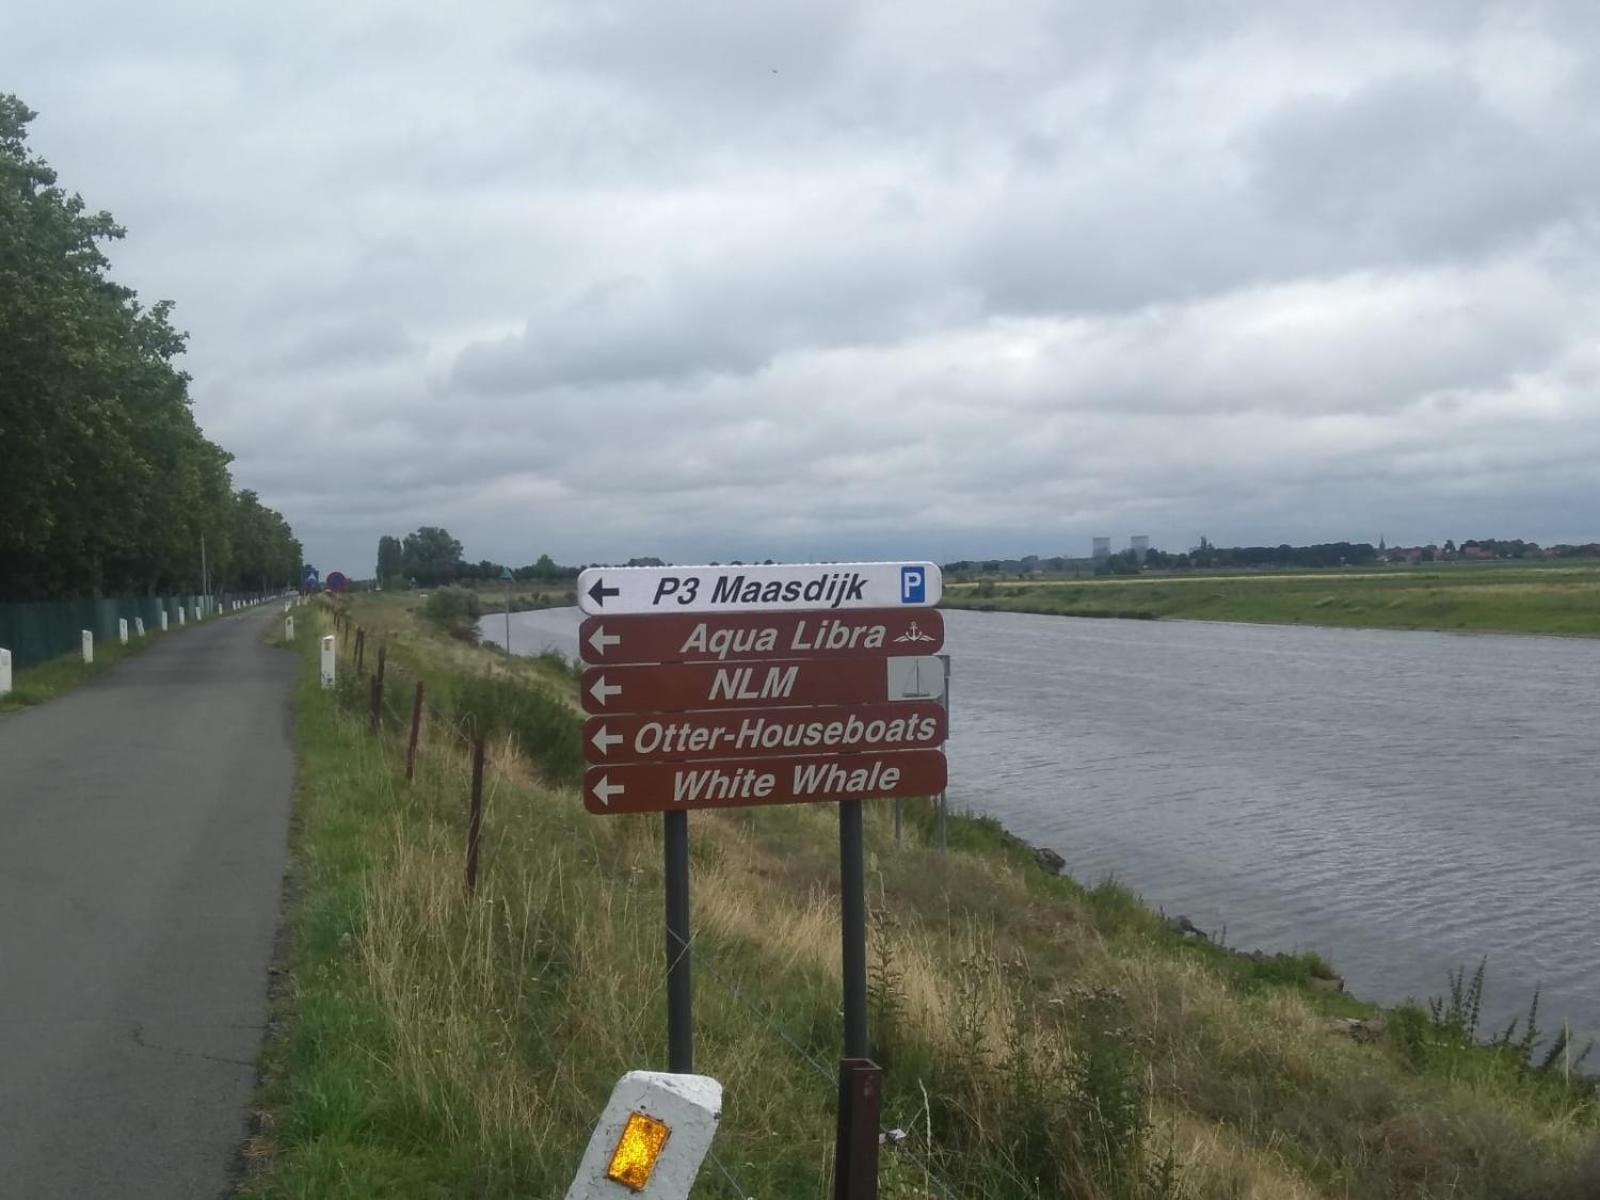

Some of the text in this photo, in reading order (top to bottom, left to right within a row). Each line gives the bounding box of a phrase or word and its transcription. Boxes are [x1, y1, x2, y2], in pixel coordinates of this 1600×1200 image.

[653, 573, 870, 608] P3 Maasdijk
[904, 571, 922, 598] P
[679, 620, 887, 660] Aqua Libra
[708, 665, 799, 701] NLM
[634, 713, 936, 754] Otter-Houseboats
[673, 761, 901, 801] White Whale
